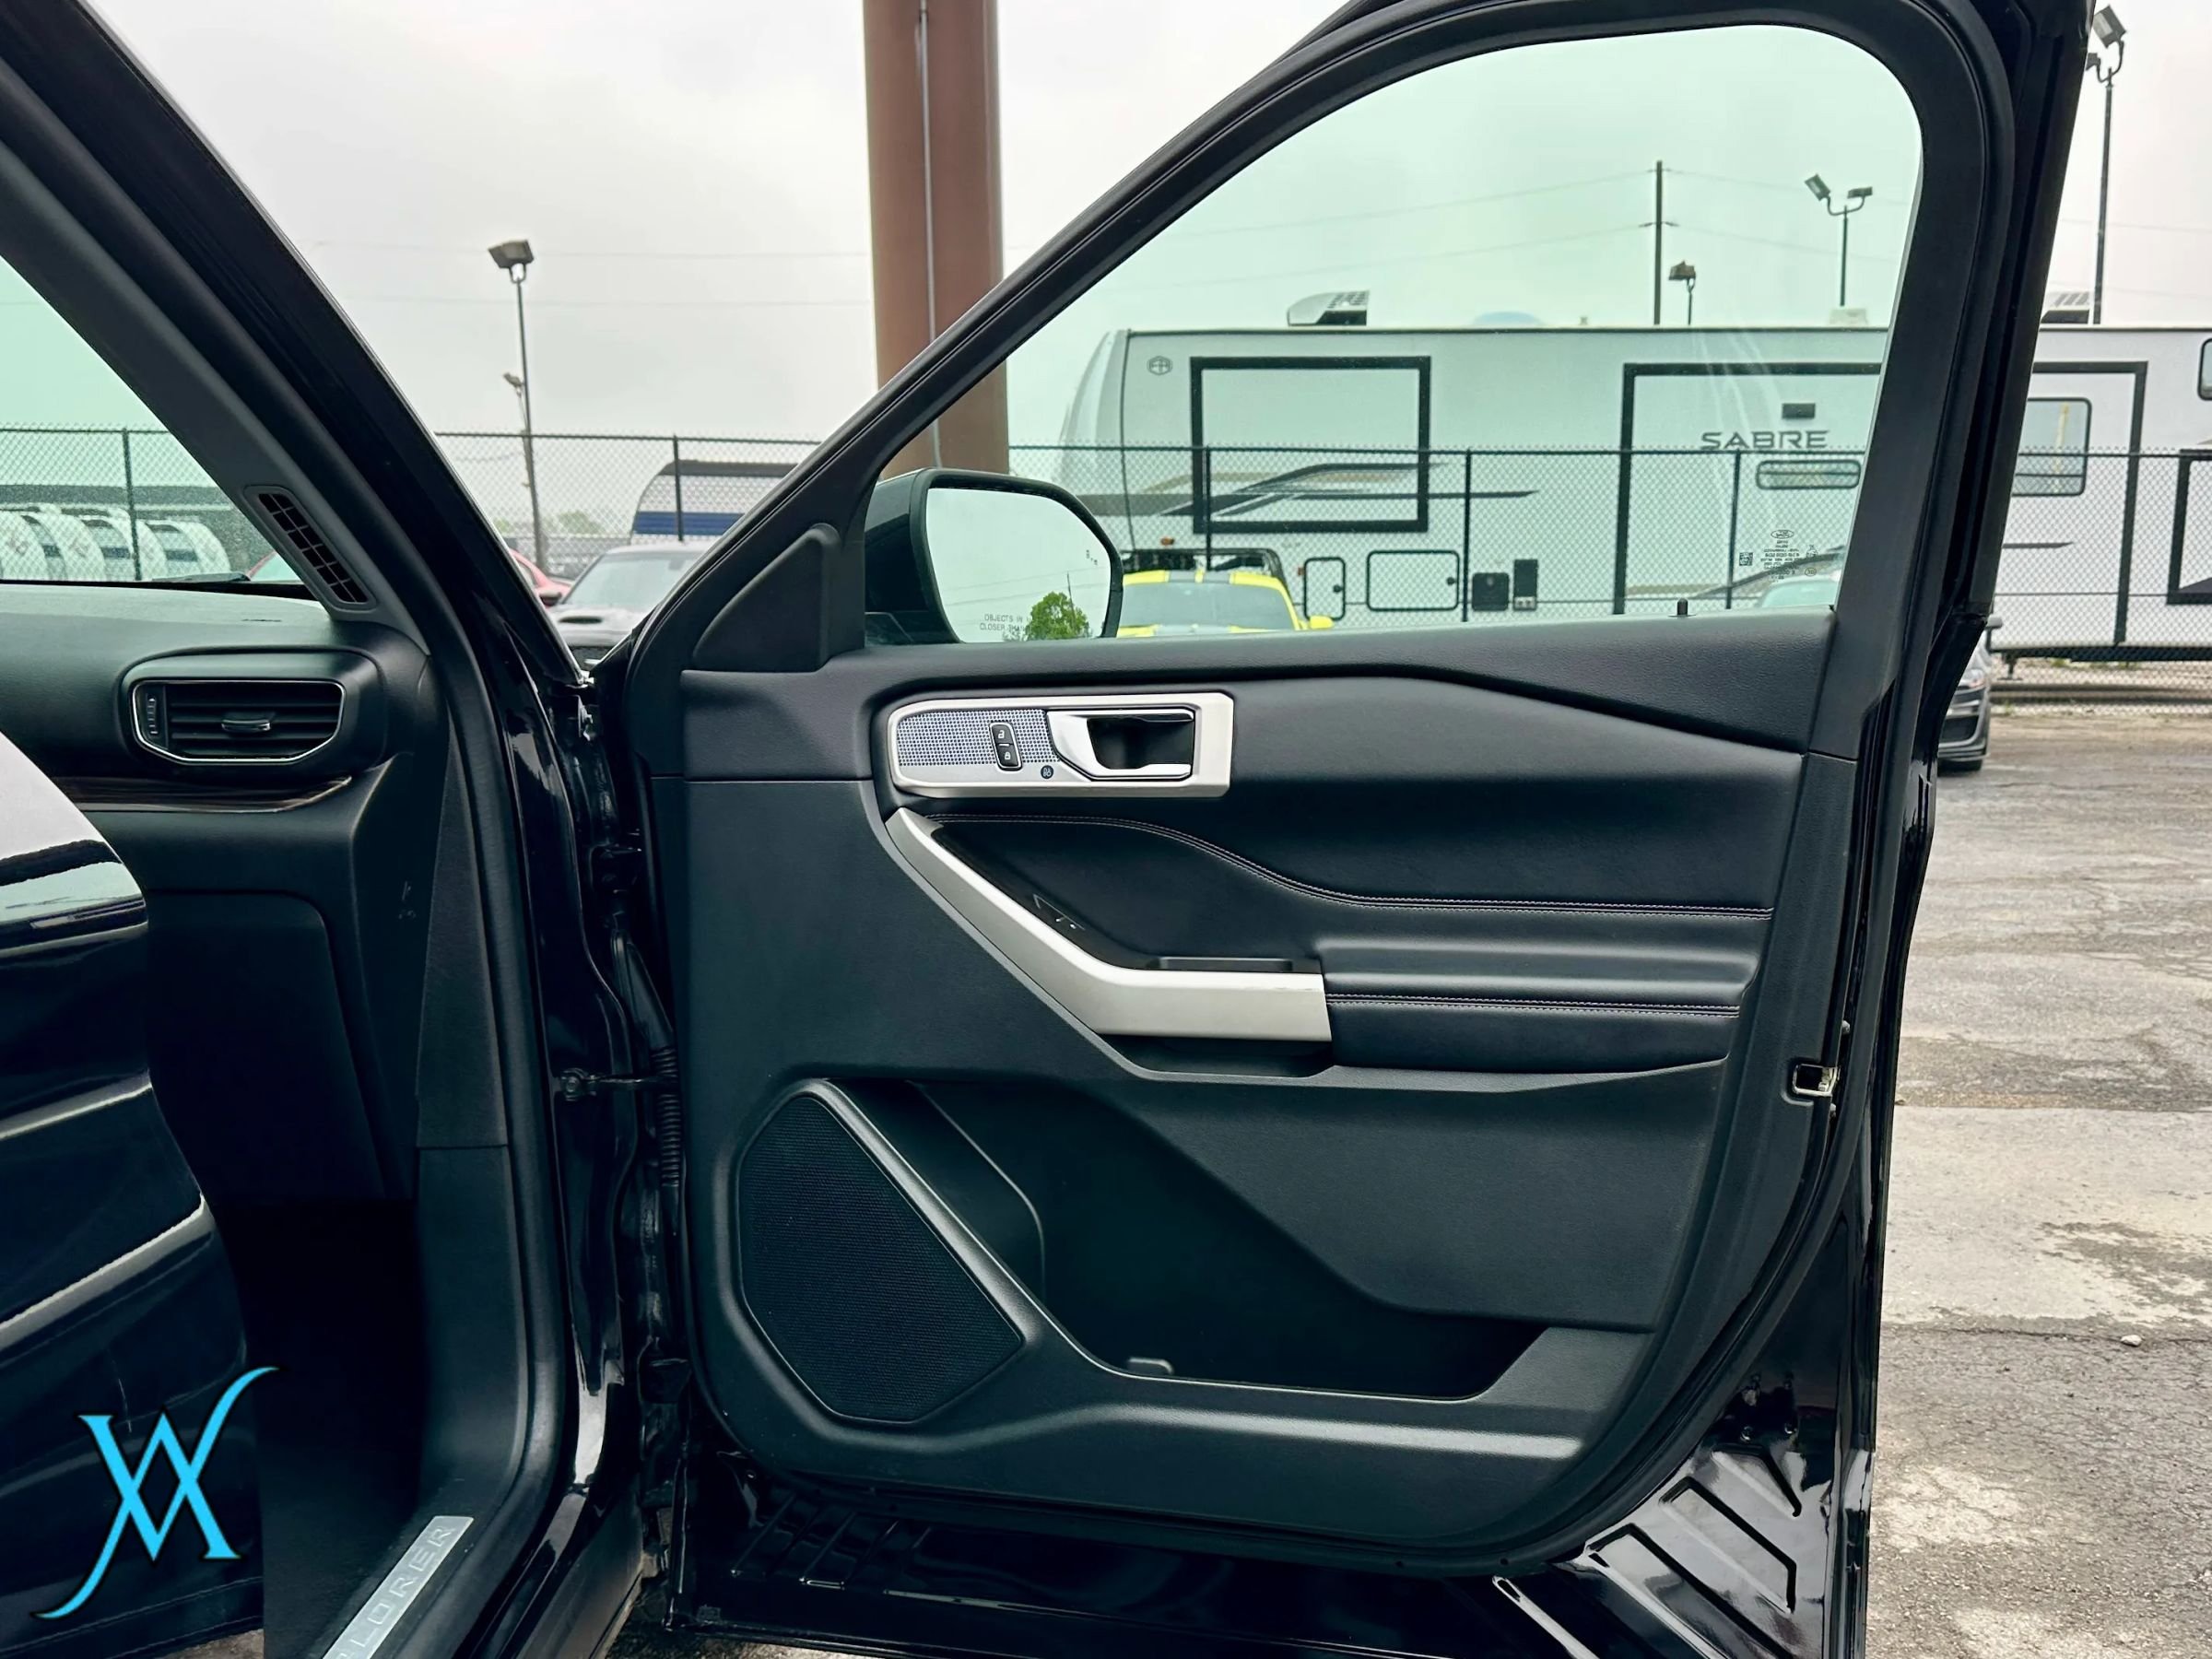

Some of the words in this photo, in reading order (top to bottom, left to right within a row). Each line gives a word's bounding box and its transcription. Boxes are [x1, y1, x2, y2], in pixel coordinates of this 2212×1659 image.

[1700, 430, 1830, 450] SABRE
[983, 614, 1014, 622] OBJECTS
[980, 622, 1006, 630] CLOSER
